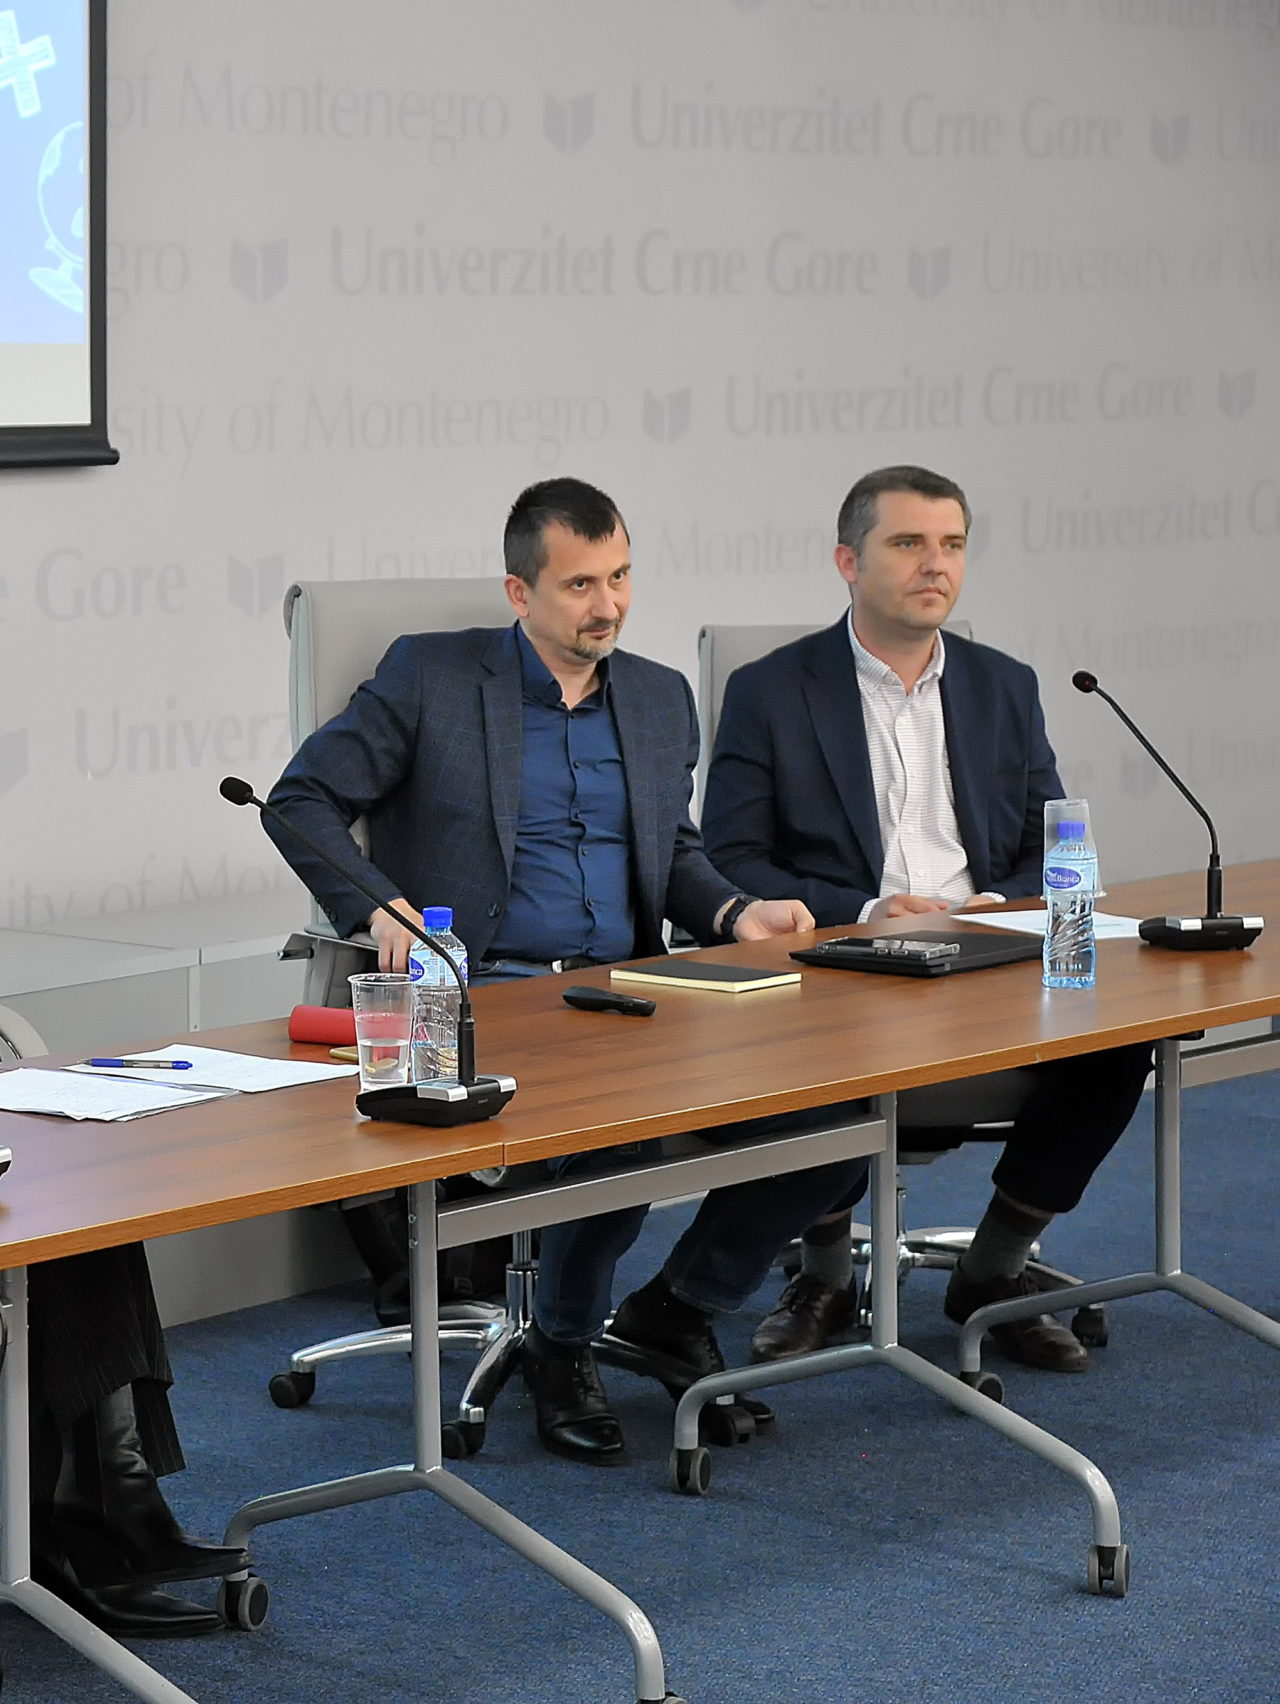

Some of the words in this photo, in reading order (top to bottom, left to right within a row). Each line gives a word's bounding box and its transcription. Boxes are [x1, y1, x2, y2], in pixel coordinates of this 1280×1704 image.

[177, 58, 510, 167] Montenegro
[631, 78, 883, 157] Univerzitet
[901, 91, 1004, 158] Crne
[1021, 96, 1123, 161] Gore
[330, 220, 616, 297] Univerzitet
[634, 228, 748, 297] Crne
[765, 230, 878, 298] Gore
[228, 376, 285, 455] of
[301, 382, 612, 468] Montenegro
[725, 366, 966, 437] Univerzitet
[982, 364, 1080, 427] Crne
[1096, 360, 1194, 422] Gore
[1021, 487, 1233, 554] Univerzitet
[34, 547, 188, 623] Gore
